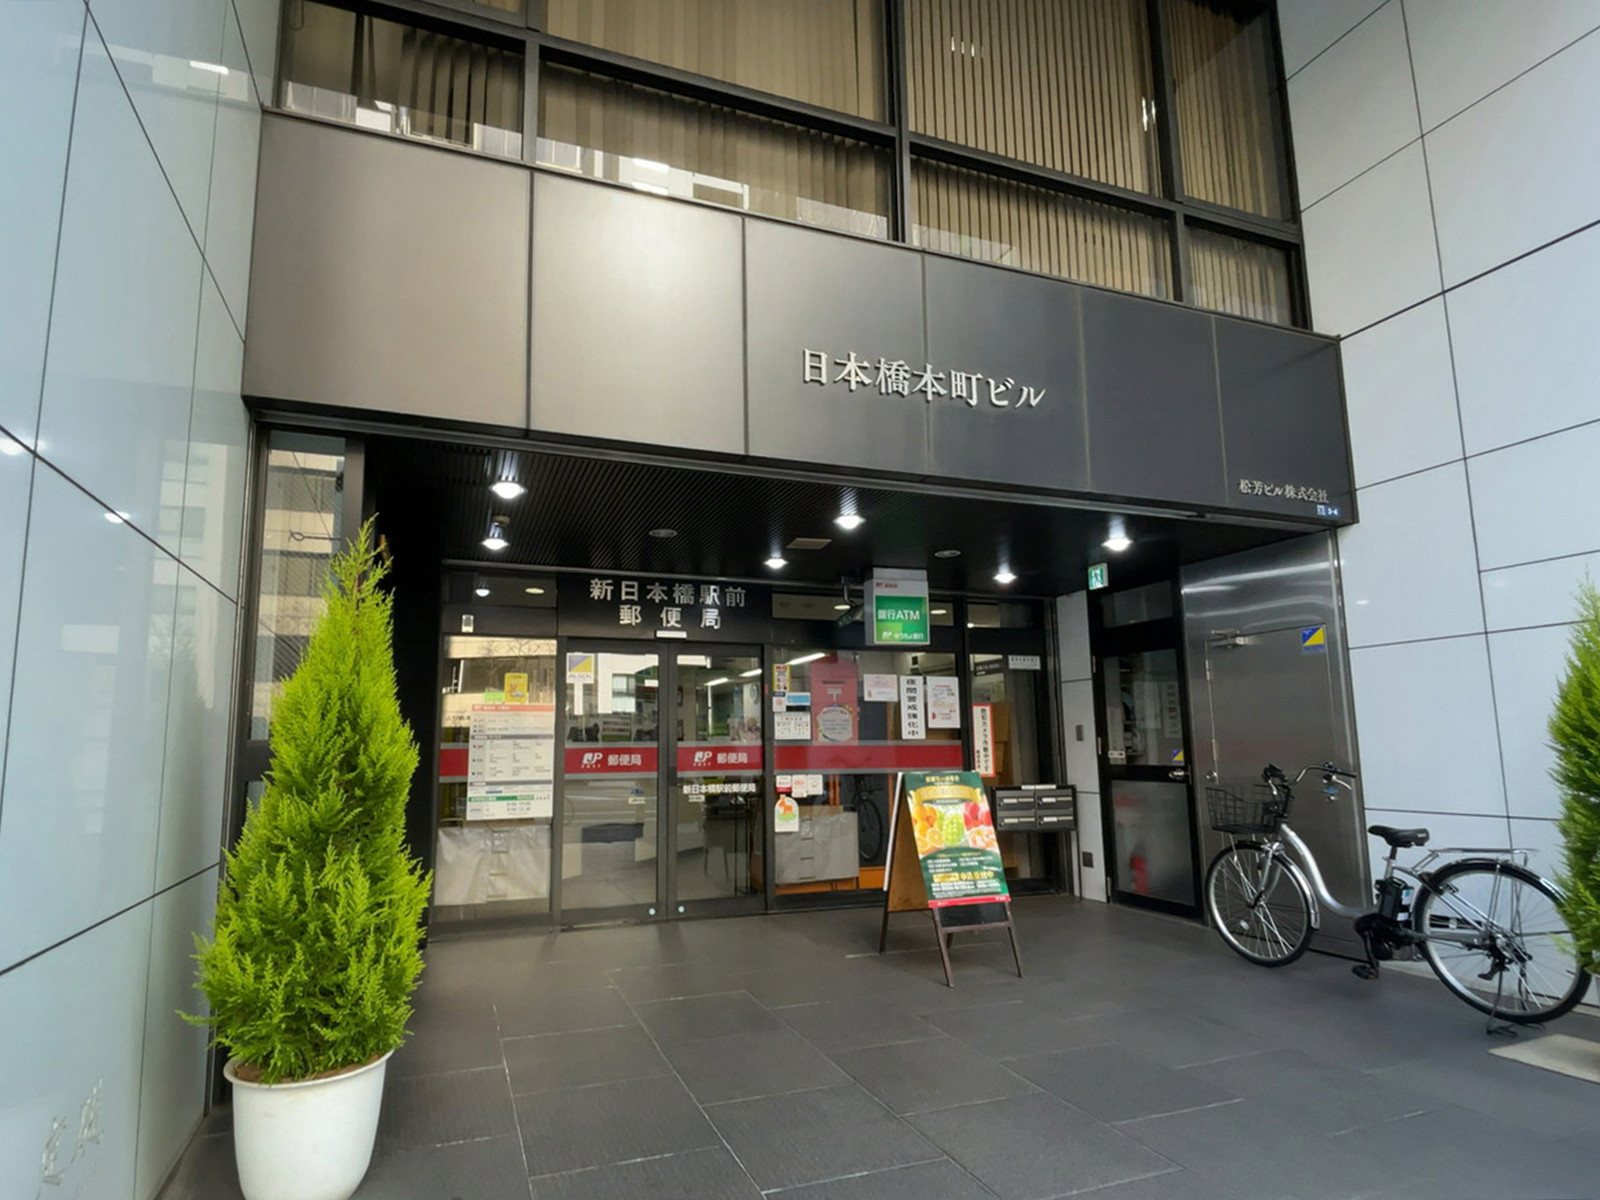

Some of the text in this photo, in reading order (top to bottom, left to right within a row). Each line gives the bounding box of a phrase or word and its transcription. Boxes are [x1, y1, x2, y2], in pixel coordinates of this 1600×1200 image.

[803, 348, 1046, 408] 日本橋本町ビル
[590, 578, 746, 607] 新日本橋駅前
[619, 604, 721, 630] 郵便局
[607, 754, 642, 766] 郵便局
[717, 752, 748, 764] 郵便局
